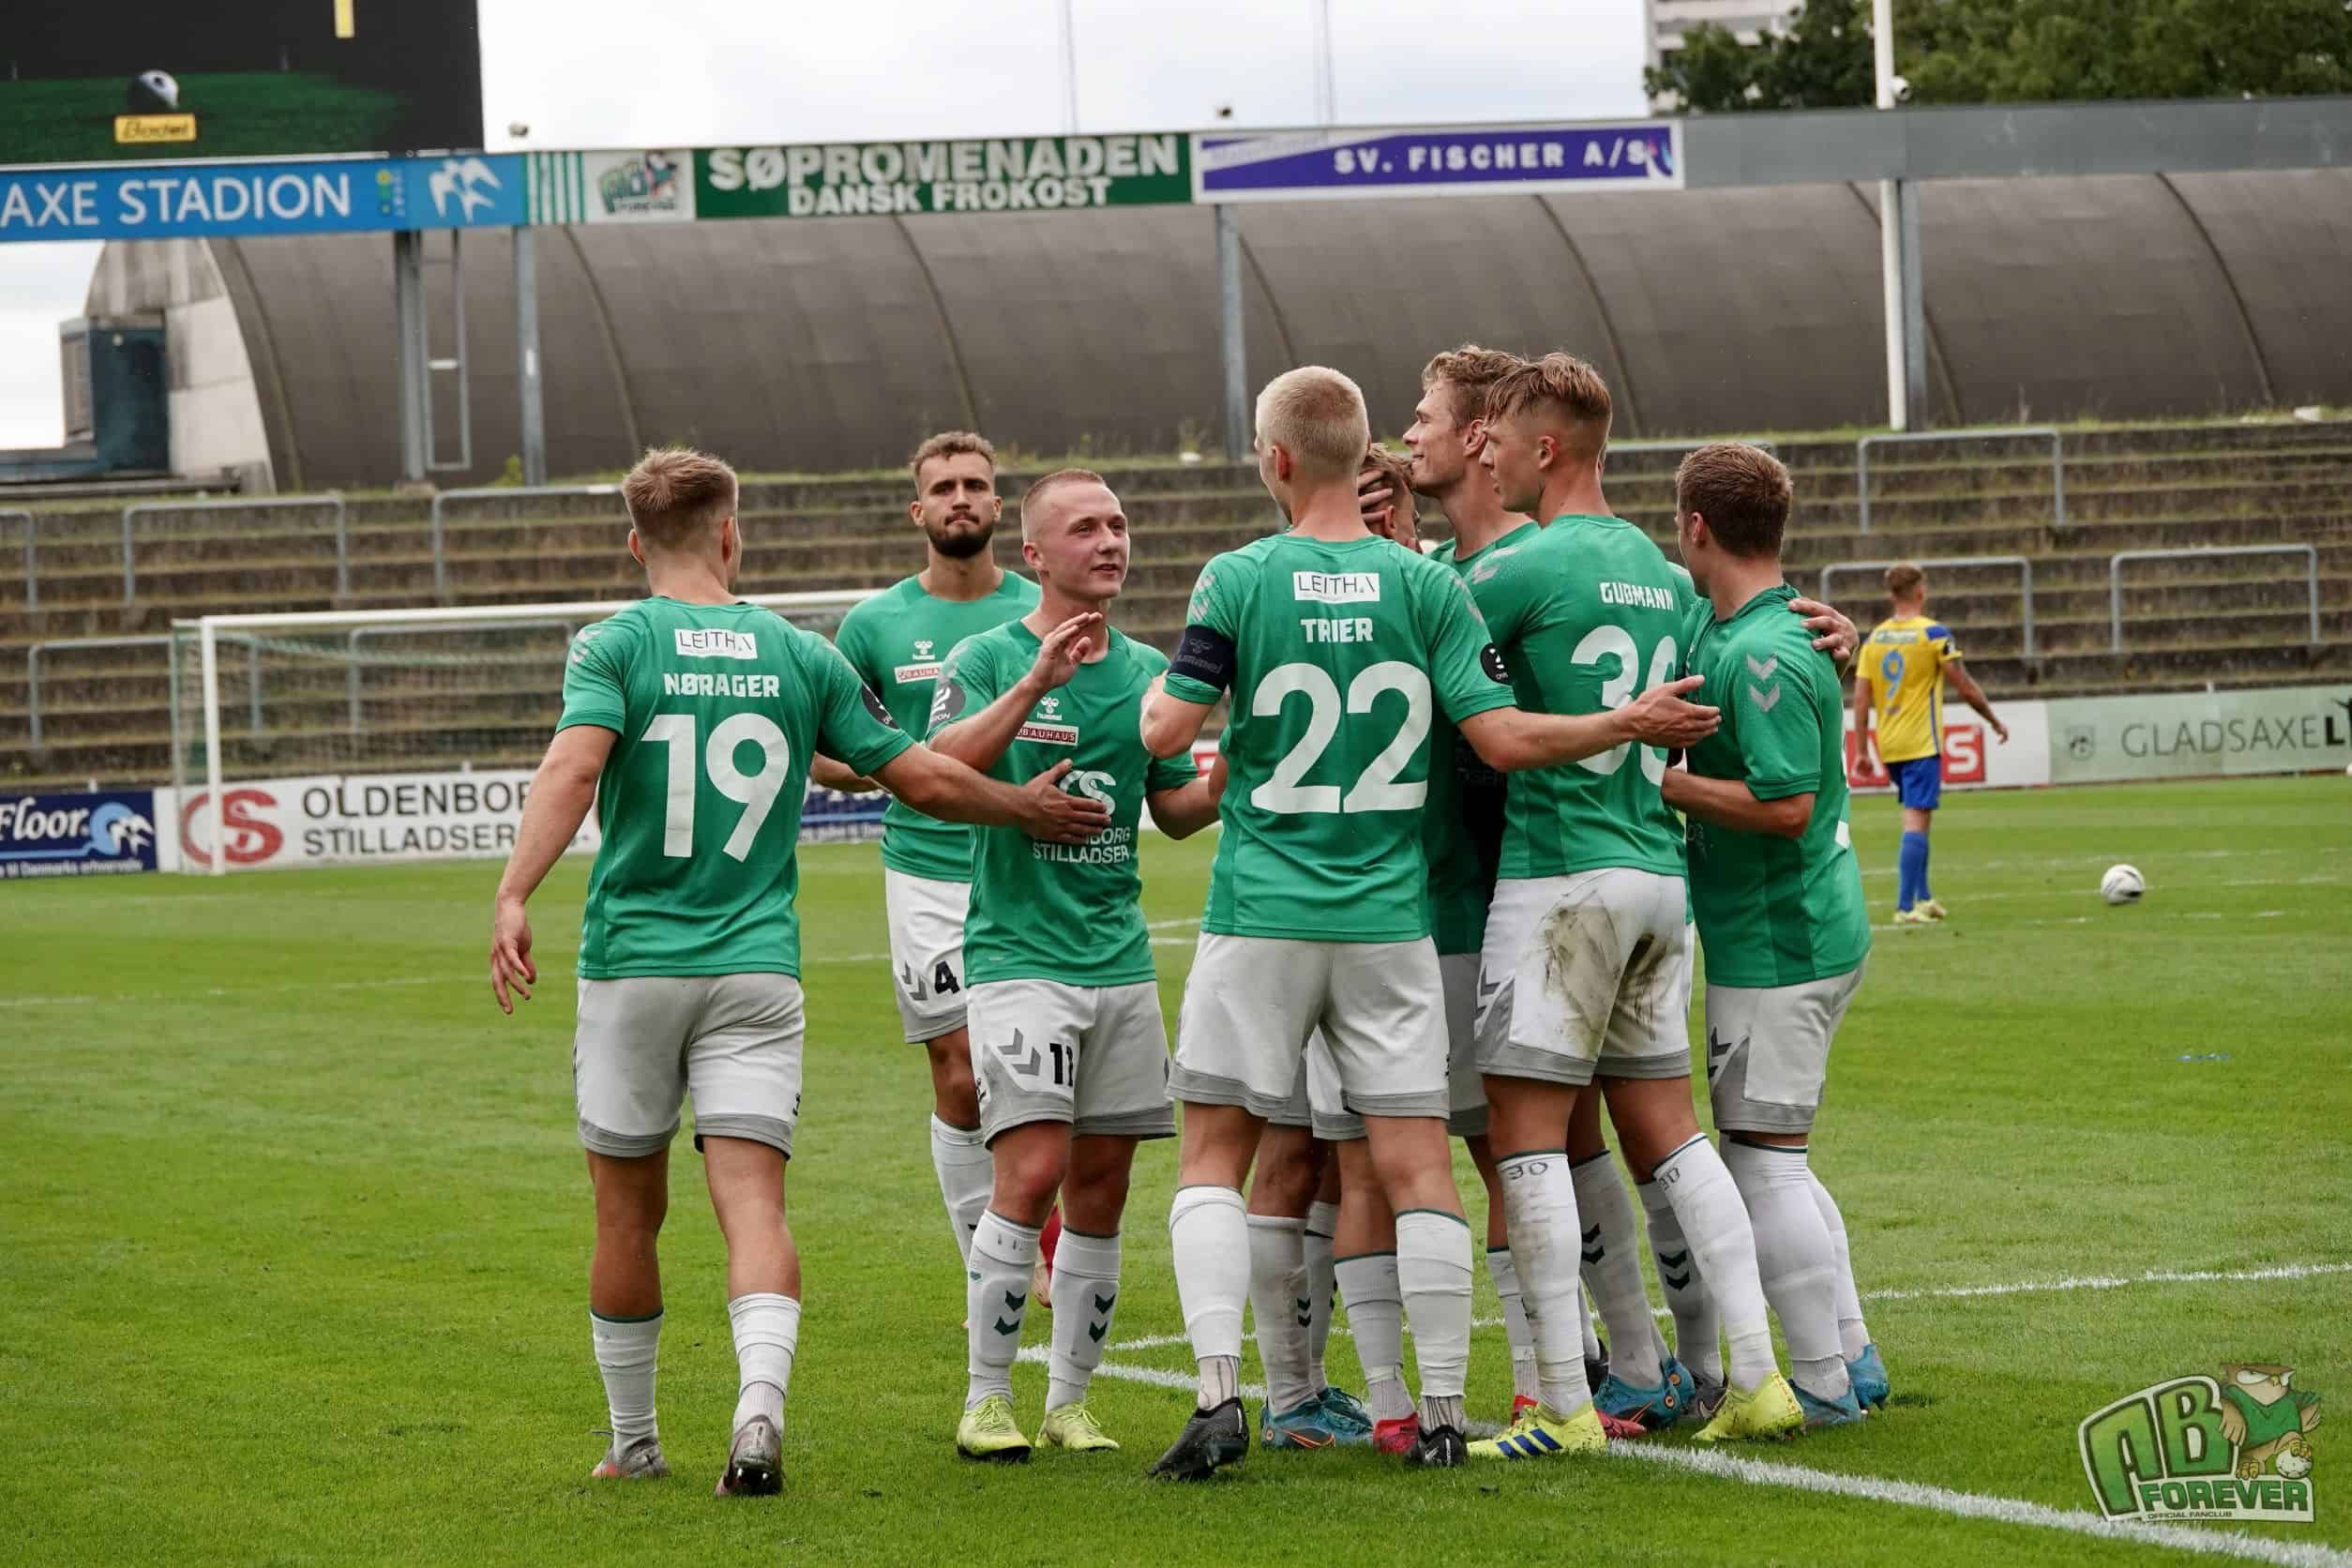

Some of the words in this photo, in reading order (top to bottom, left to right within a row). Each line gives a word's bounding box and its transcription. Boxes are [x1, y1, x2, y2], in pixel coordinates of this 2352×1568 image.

[707, 133, 1180, 191] SØPROMENADEN
[1333, 147, 1394, 175] SV.
[1407, 142, 1564, 173] FISCHER
[1582, 136, 1646, 170] A/S
[0, 182, 99, 228] AXE
[117, 173, 352, 225] STADION
[788, 182, 923, 216] DANSK
[931, 175, 1113, 211] FROKOST
[1300, 617, 1374, 643] TRIER
[662, 672, 780, 698] NØRAGER
[1881, 650, 1905, 699] 9
[1022, 728, 1075, 741] BAUHAUS
[1250, 660, 1432, 814] 22
[641, 712, 790, 863] 19
[303, 823, 517, 856] STILLADSER
[1033, 842, 1130, 864] STILLADSER
[933, 960, 959, 997] 4
[1505, 1161, 1549, 1181] 30
